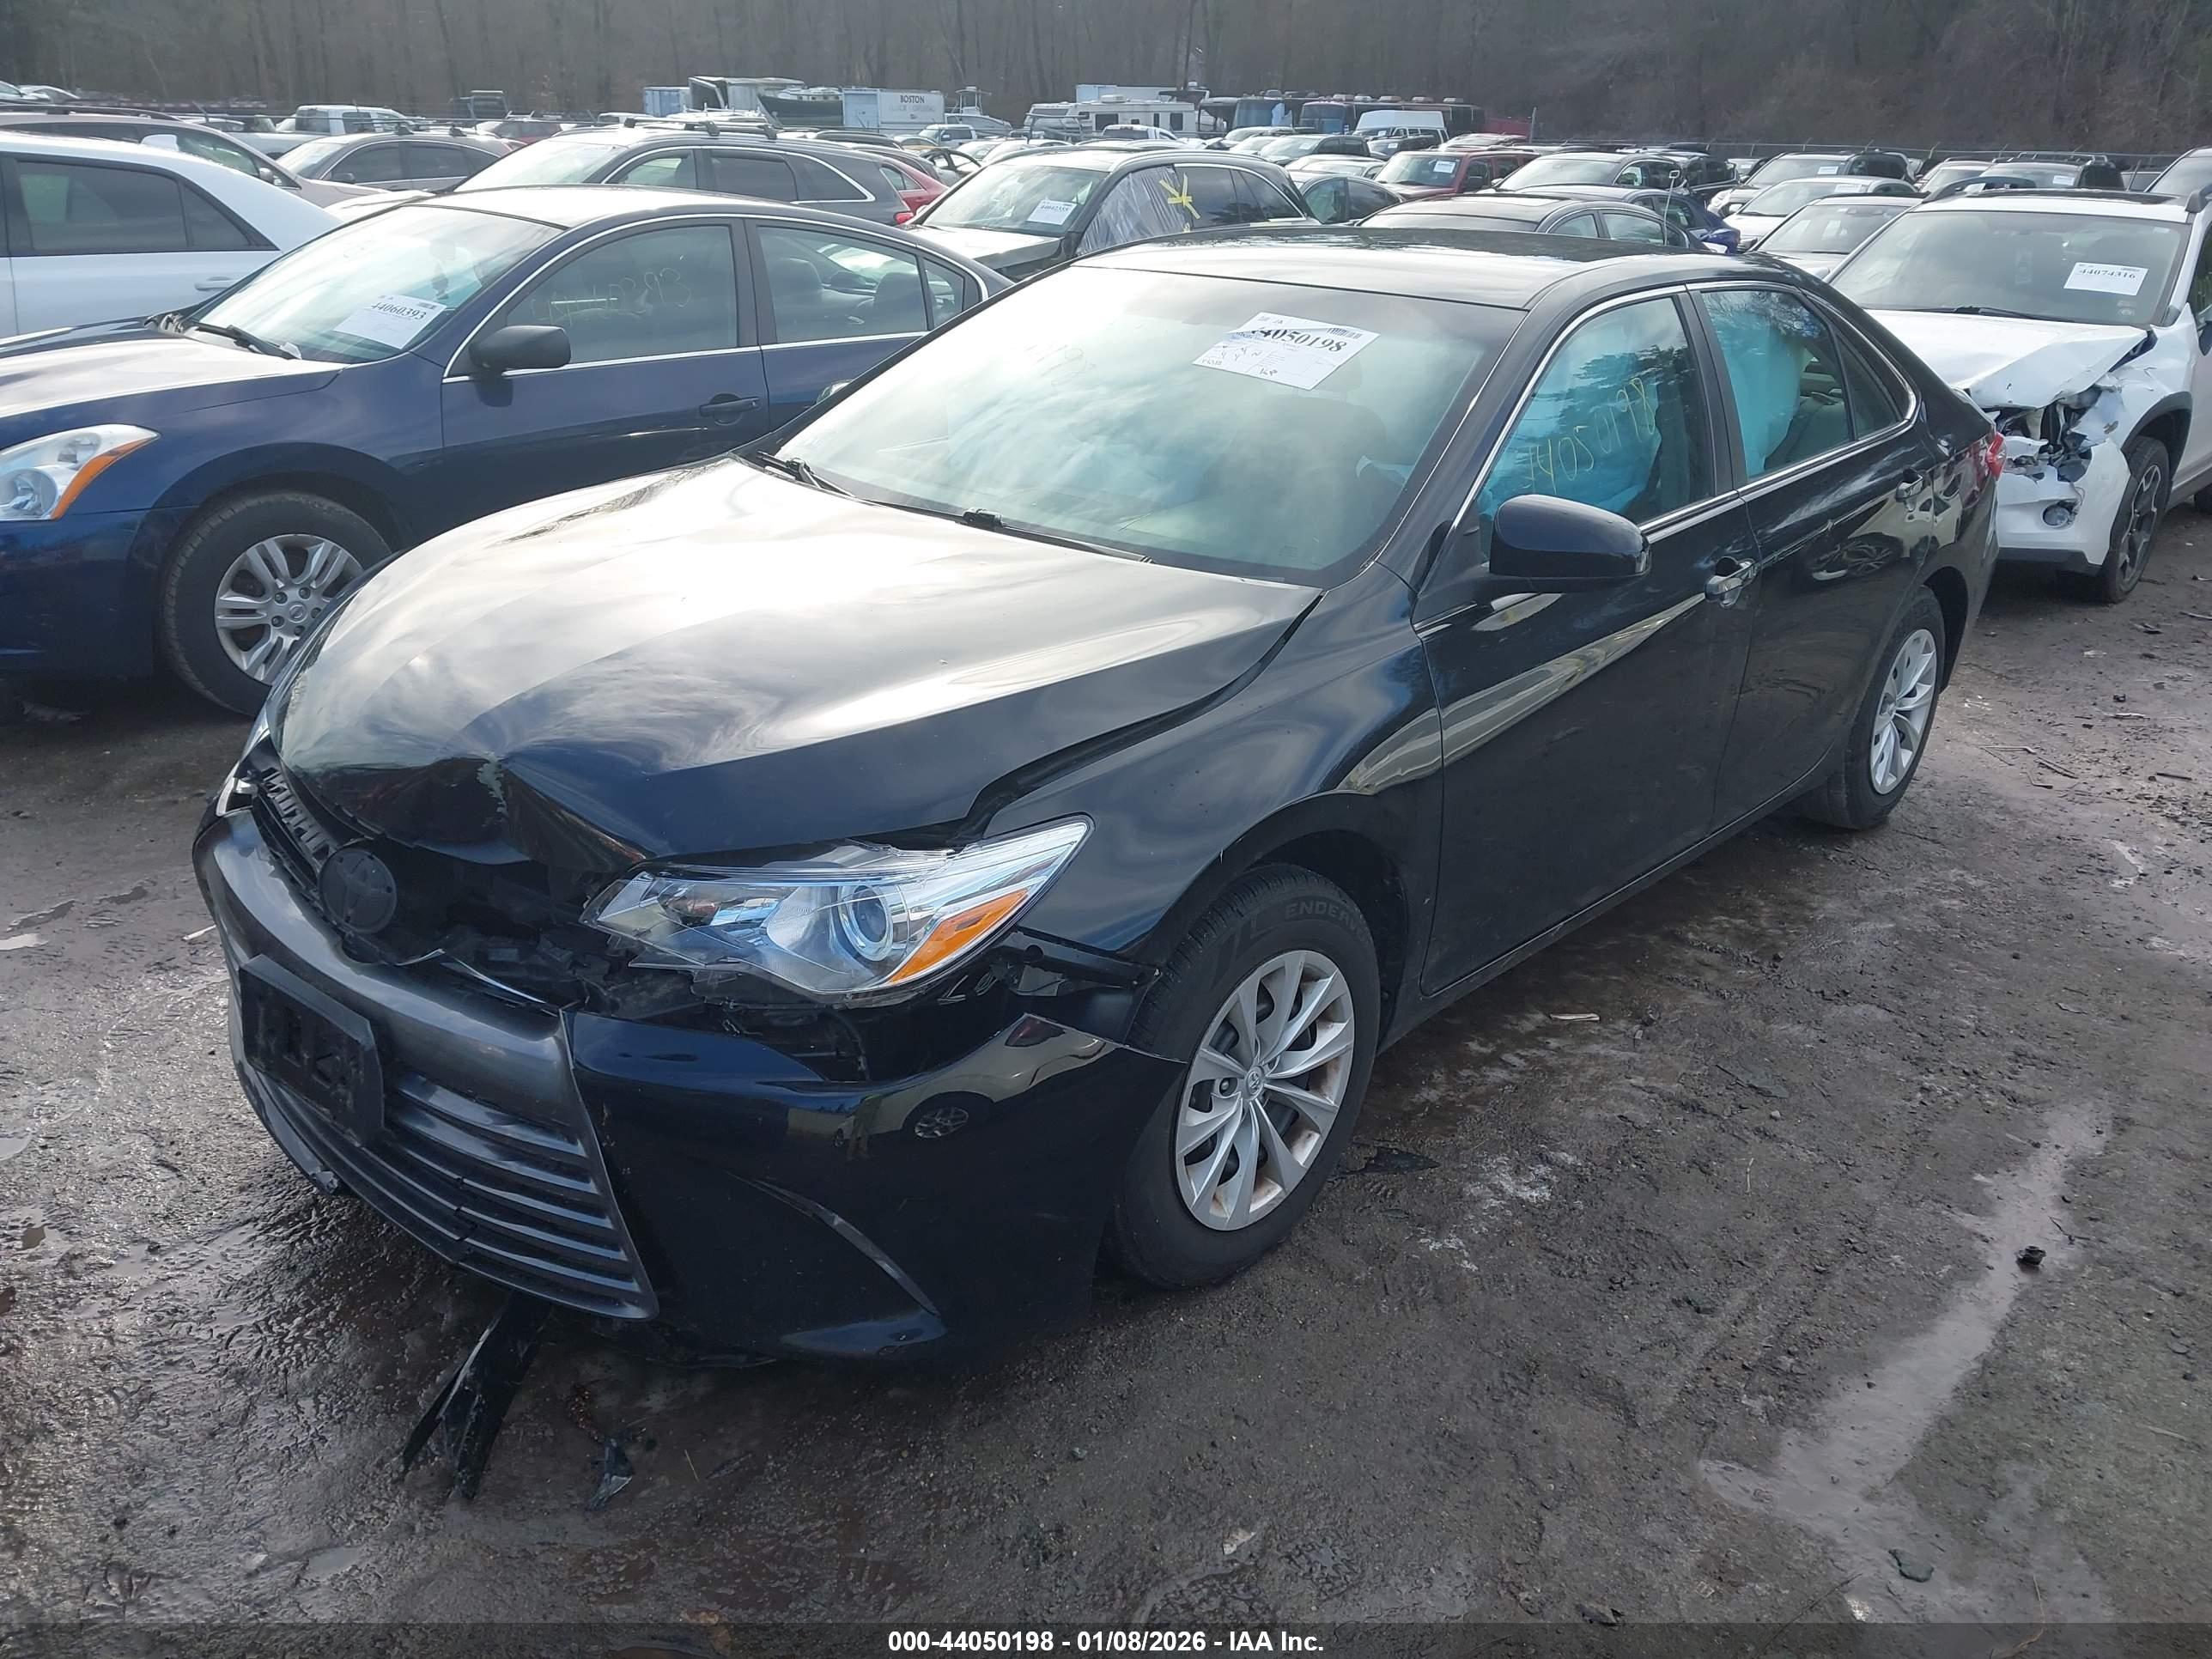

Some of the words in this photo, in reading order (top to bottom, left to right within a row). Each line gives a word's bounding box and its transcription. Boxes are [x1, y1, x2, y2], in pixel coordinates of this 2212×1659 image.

[900, 95, 926, 104] BOSTON
[371, 302, 428, 320] 44060393
[1251, 326, 1347, 353] 4050198
